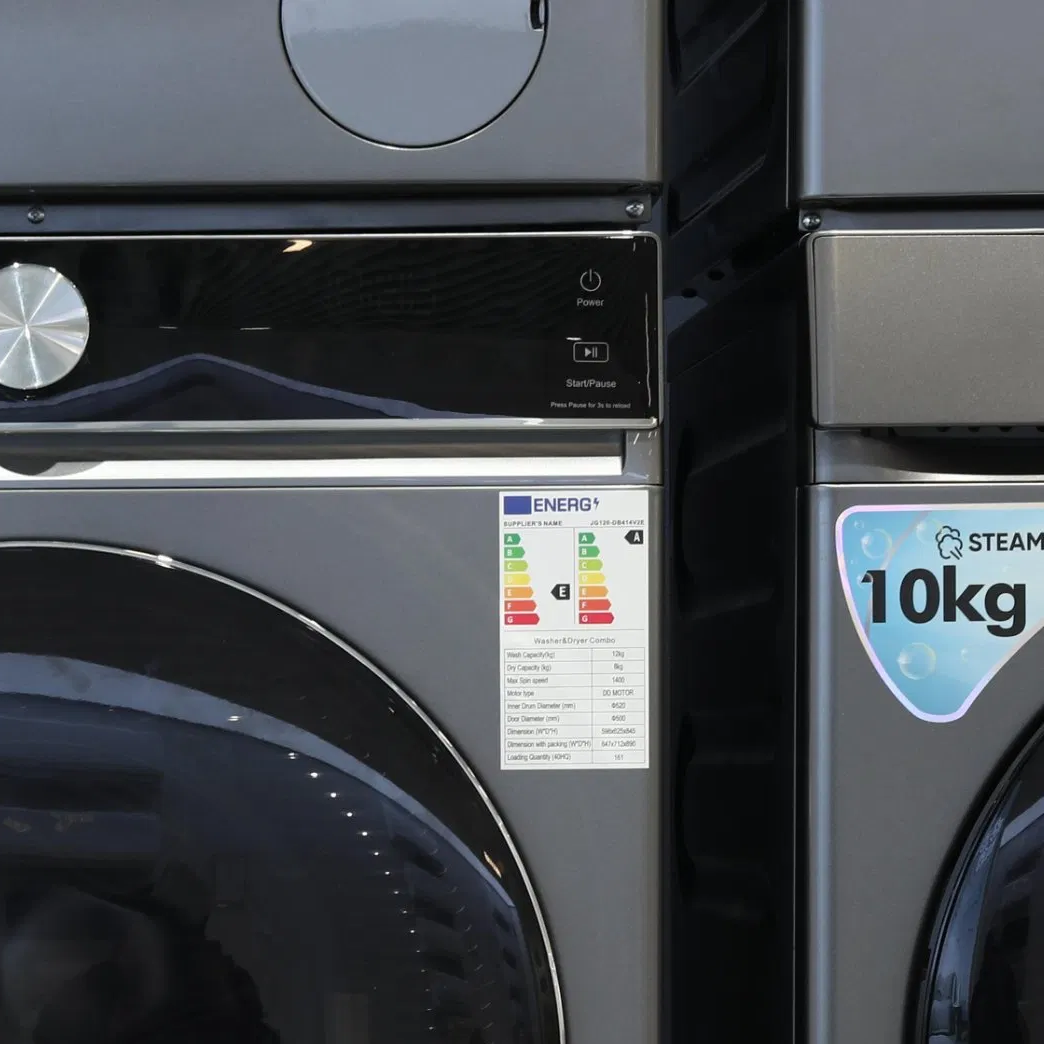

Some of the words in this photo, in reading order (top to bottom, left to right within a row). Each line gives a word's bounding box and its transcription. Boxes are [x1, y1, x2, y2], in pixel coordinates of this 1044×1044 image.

[577, 298, 604, 306] Power
[566, 379, 617, 388] Start/Pause
[507, 535, 513, 543] A
[633, 532, 641, 542] A
[968, 532, 1044, 552] STEAM
[559, 586, 566, 597] E
[861, 565, 1026, 638] 10kg
[534, 637, 588, 645] Washer&Dryer
